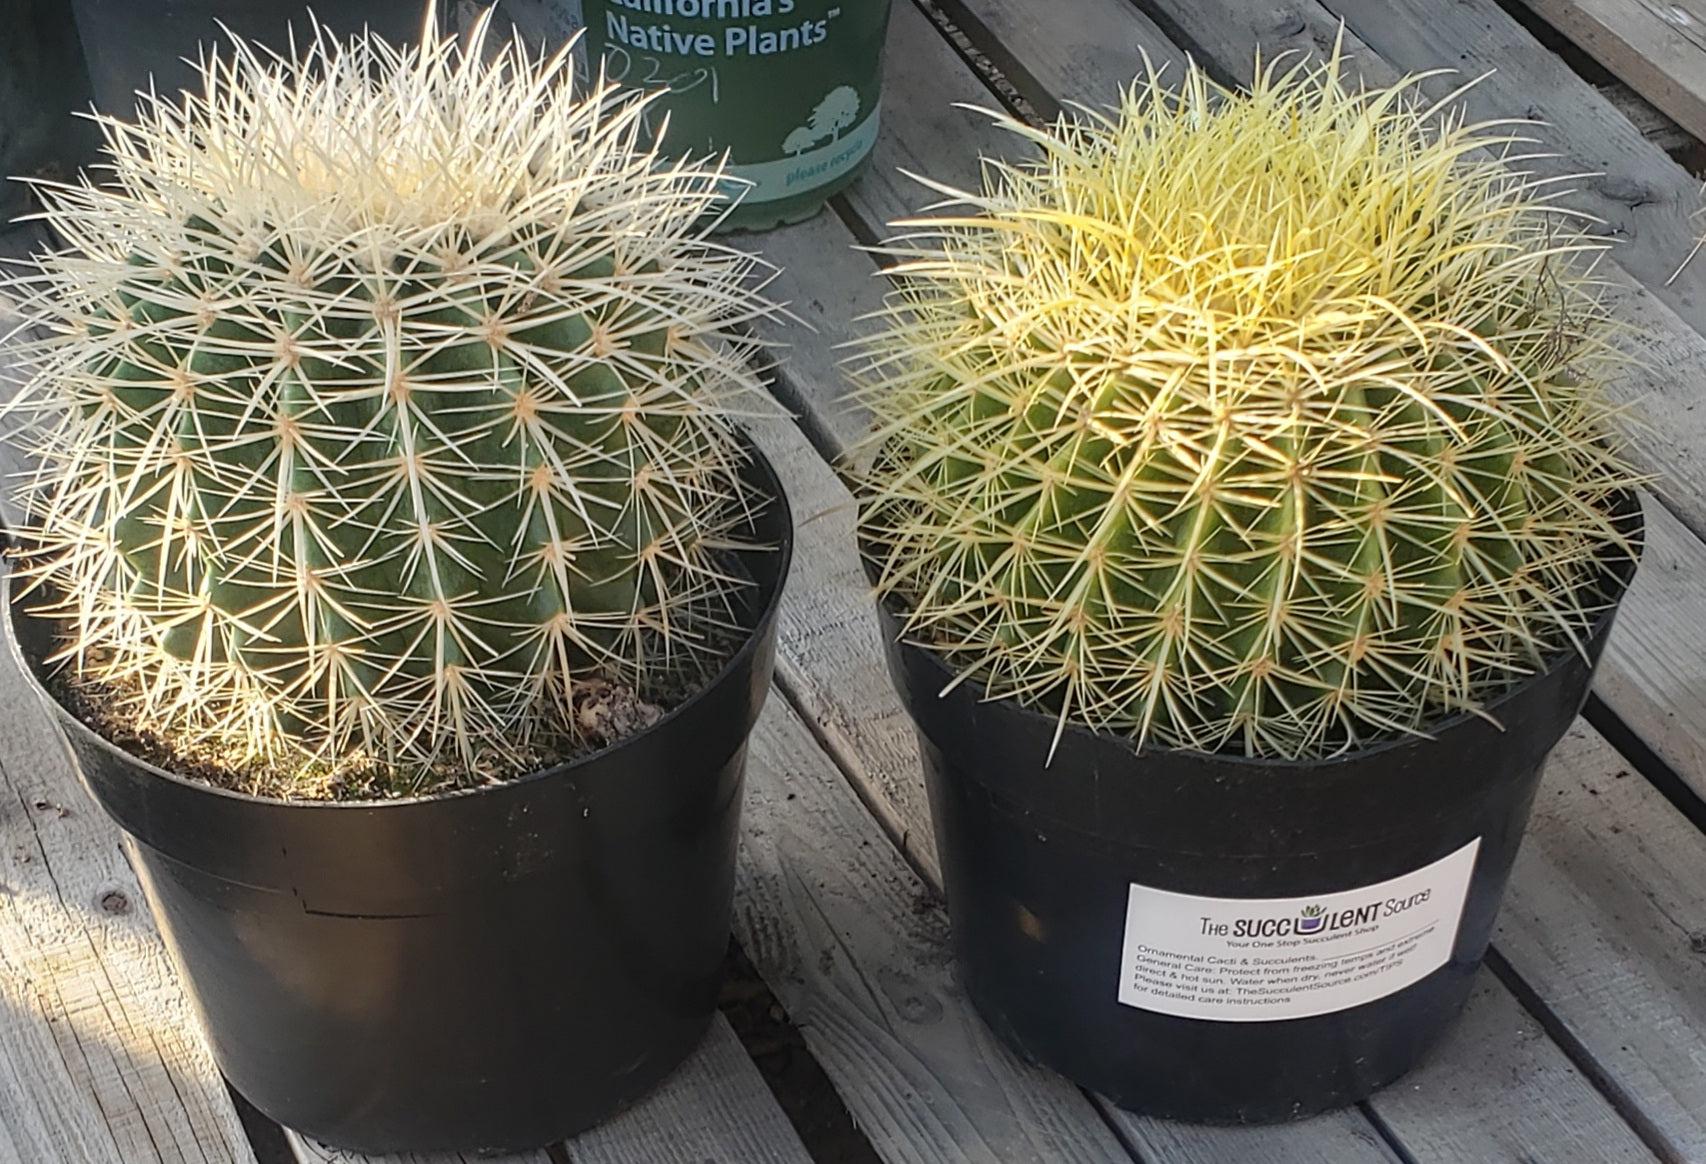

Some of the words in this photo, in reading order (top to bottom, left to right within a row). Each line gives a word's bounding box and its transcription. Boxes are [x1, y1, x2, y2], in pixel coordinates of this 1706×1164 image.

[610, 0, 794, 17] ornias
[606, 9, 715, 56] Native
[786, 161, 828, 187] please
[1383, 888, 1431, 918] Source
[1226, 940, 1250, 948] Your
[1252, 940, 1274, 948] One
[1276, 938, 1300, 948] Stop
[1303, 931, 1352, 944] Succulent
[1354, 924, 1379, 936] Shop
[1136, 954, 1181, 970] General
[1219, 967, 1260, 976] Protect
[1263, 966, 1289, 975] from
[1292, 959, 1338, 974] freezing
[1341, 951, 1373, 966] temps
[1376, 944, 1396, 957] and
[1137, 944, 1204, 963] Ornamental
[1207, 956, 1237, 966] Cacti
[1240, 957, 1249, 966] &
[1134, 973, 1172, 988] Please
[1176, 982, 1198, 992] visit
[1135, 964, 1166, 977] direct
[1169, 971, 1178, 979] &
[1180, 973, 1199, 982] hot
[1230, 977, 1264, 985] Water
[1267, 976, 1298, 985] when
[1324, 967, 1356, 978] never
[1358, 957, 1386, 971] water
[1133, 983, 1149, 993] for
[1151, 986, 1195, 1001] detailed
[1198, 995, 1223, 1004] care
[1226, 996, 1290, 1005] instructions
